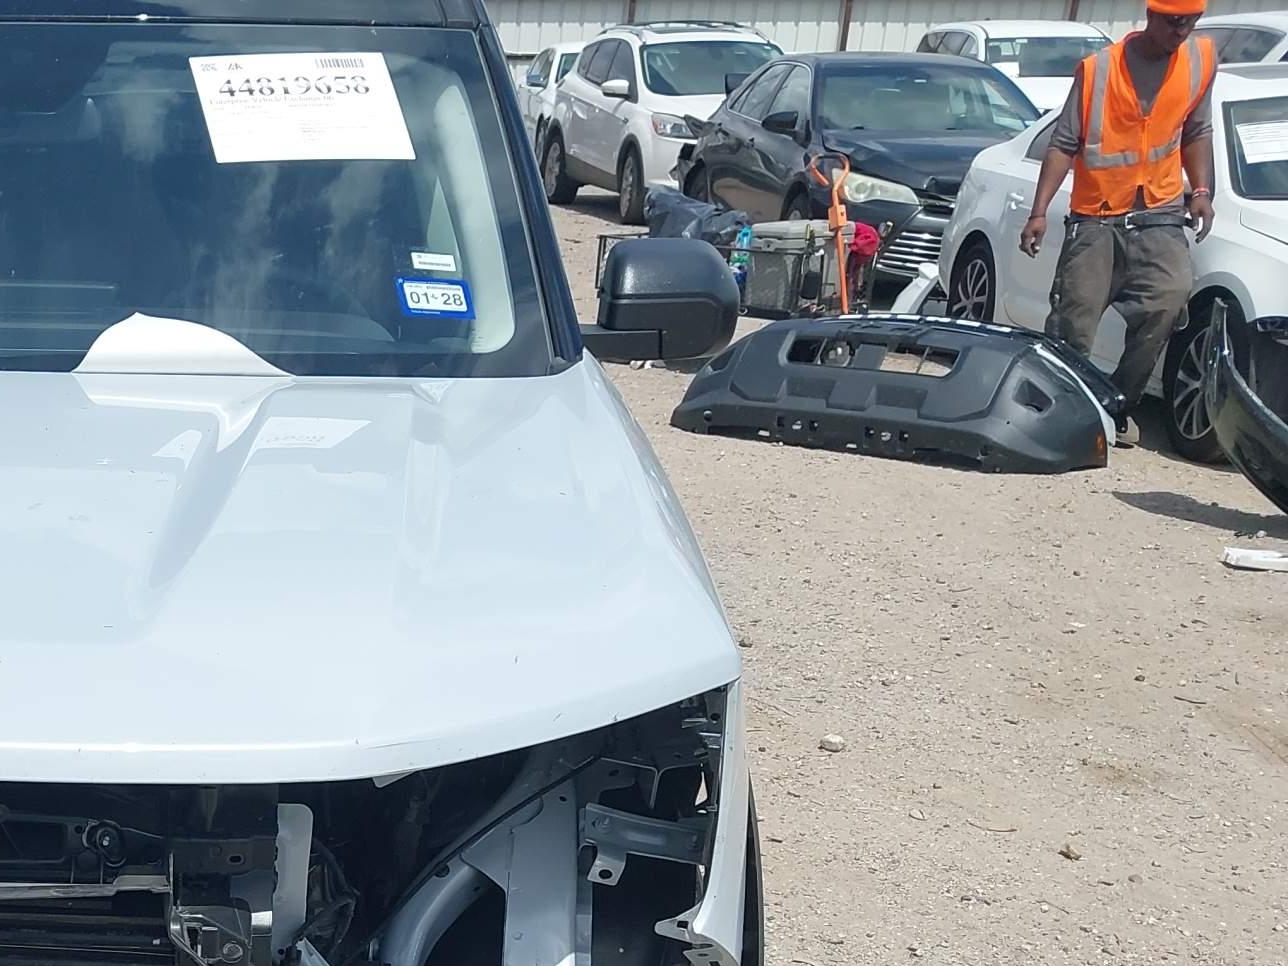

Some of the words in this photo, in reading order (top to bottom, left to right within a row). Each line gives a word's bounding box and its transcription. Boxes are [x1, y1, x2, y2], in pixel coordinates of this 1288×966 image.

[218, 75, 370, 97] 44819658
[409, 291, 430, 305] 01
[440, 292, 464, 307] 28
